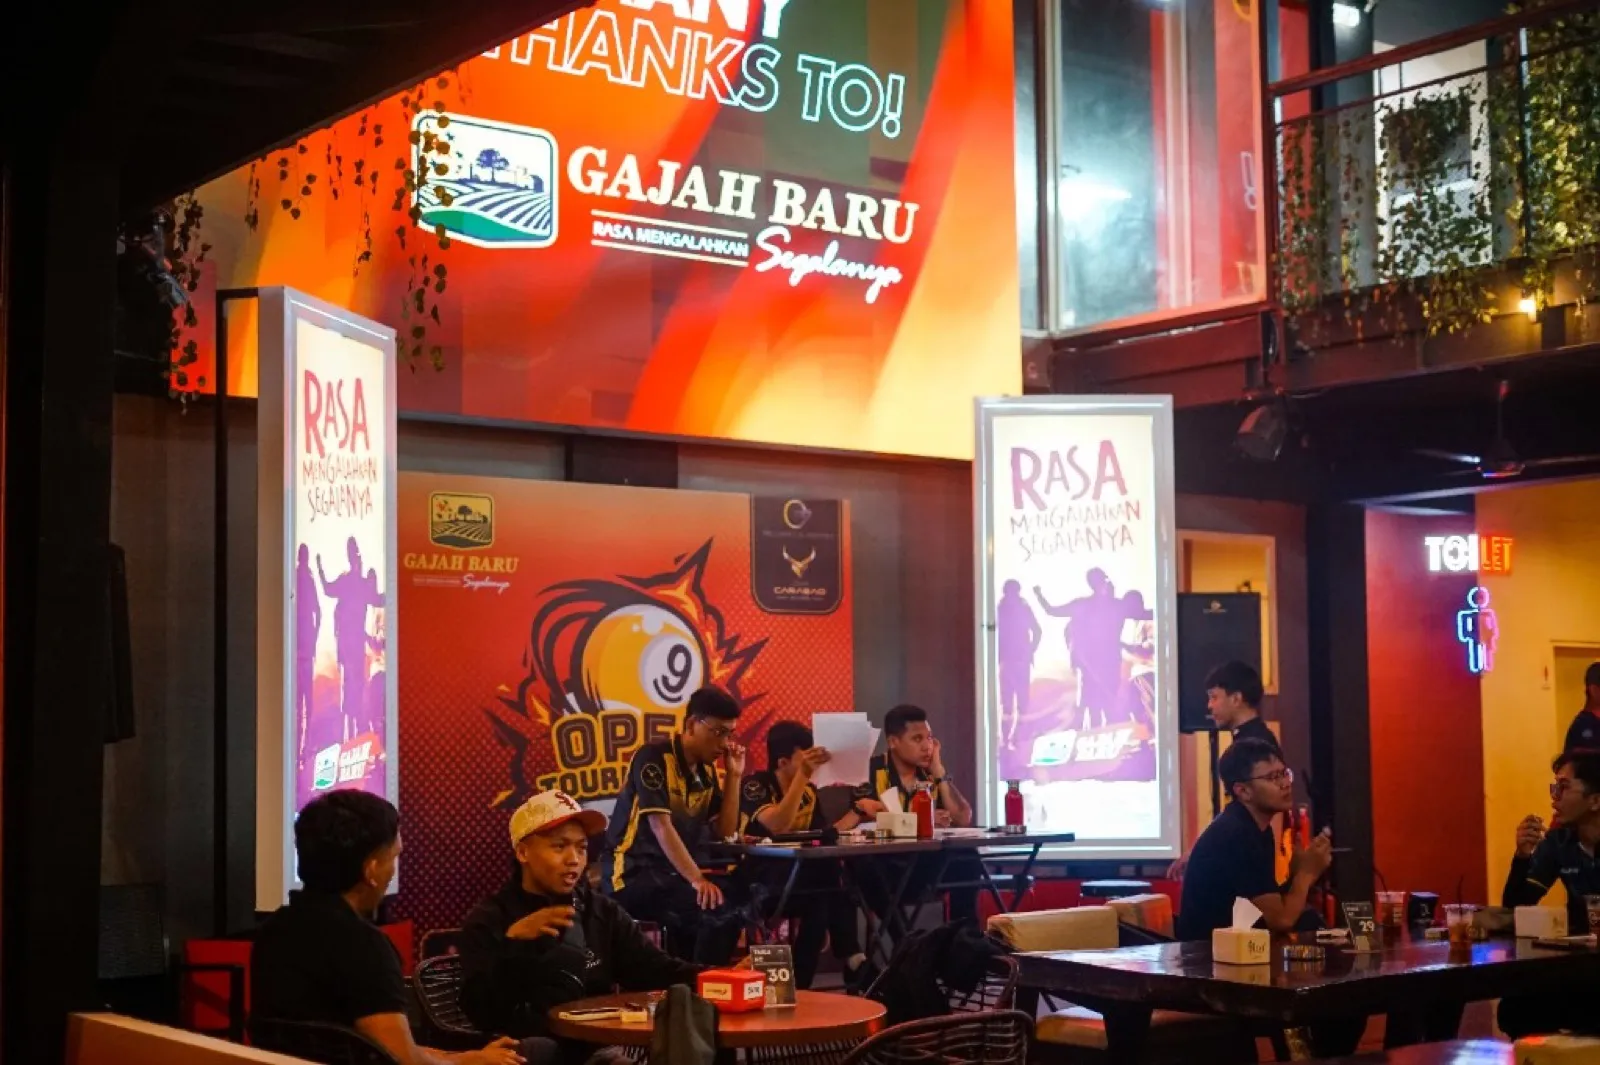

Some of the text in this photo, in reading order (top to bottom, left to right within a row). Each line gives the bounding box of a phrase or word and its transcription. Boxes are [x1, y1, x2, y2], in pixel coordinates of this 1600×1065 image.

[481, 9, 781, 112] HANKS
[797, 53, 905, 138] TO!
[566, 146, 920, 243] GAJAH BARU
[592, 220, 633, 242] RASA
[635, 230, 749, 258] MENGALAHKAN
[304, 369, 370, 459] RASA
[1010, 439, 1128, 511] RASA
[403, 553, 520, 573] GAJAH BARU
[1425, 534, 1514, 571] TOILET
[661, 643, 693, 694] 9
[555, 712, 677, 769] OPE
[540, 767, 626, 798] TOUR
[767, 968, 790, 982] 30
